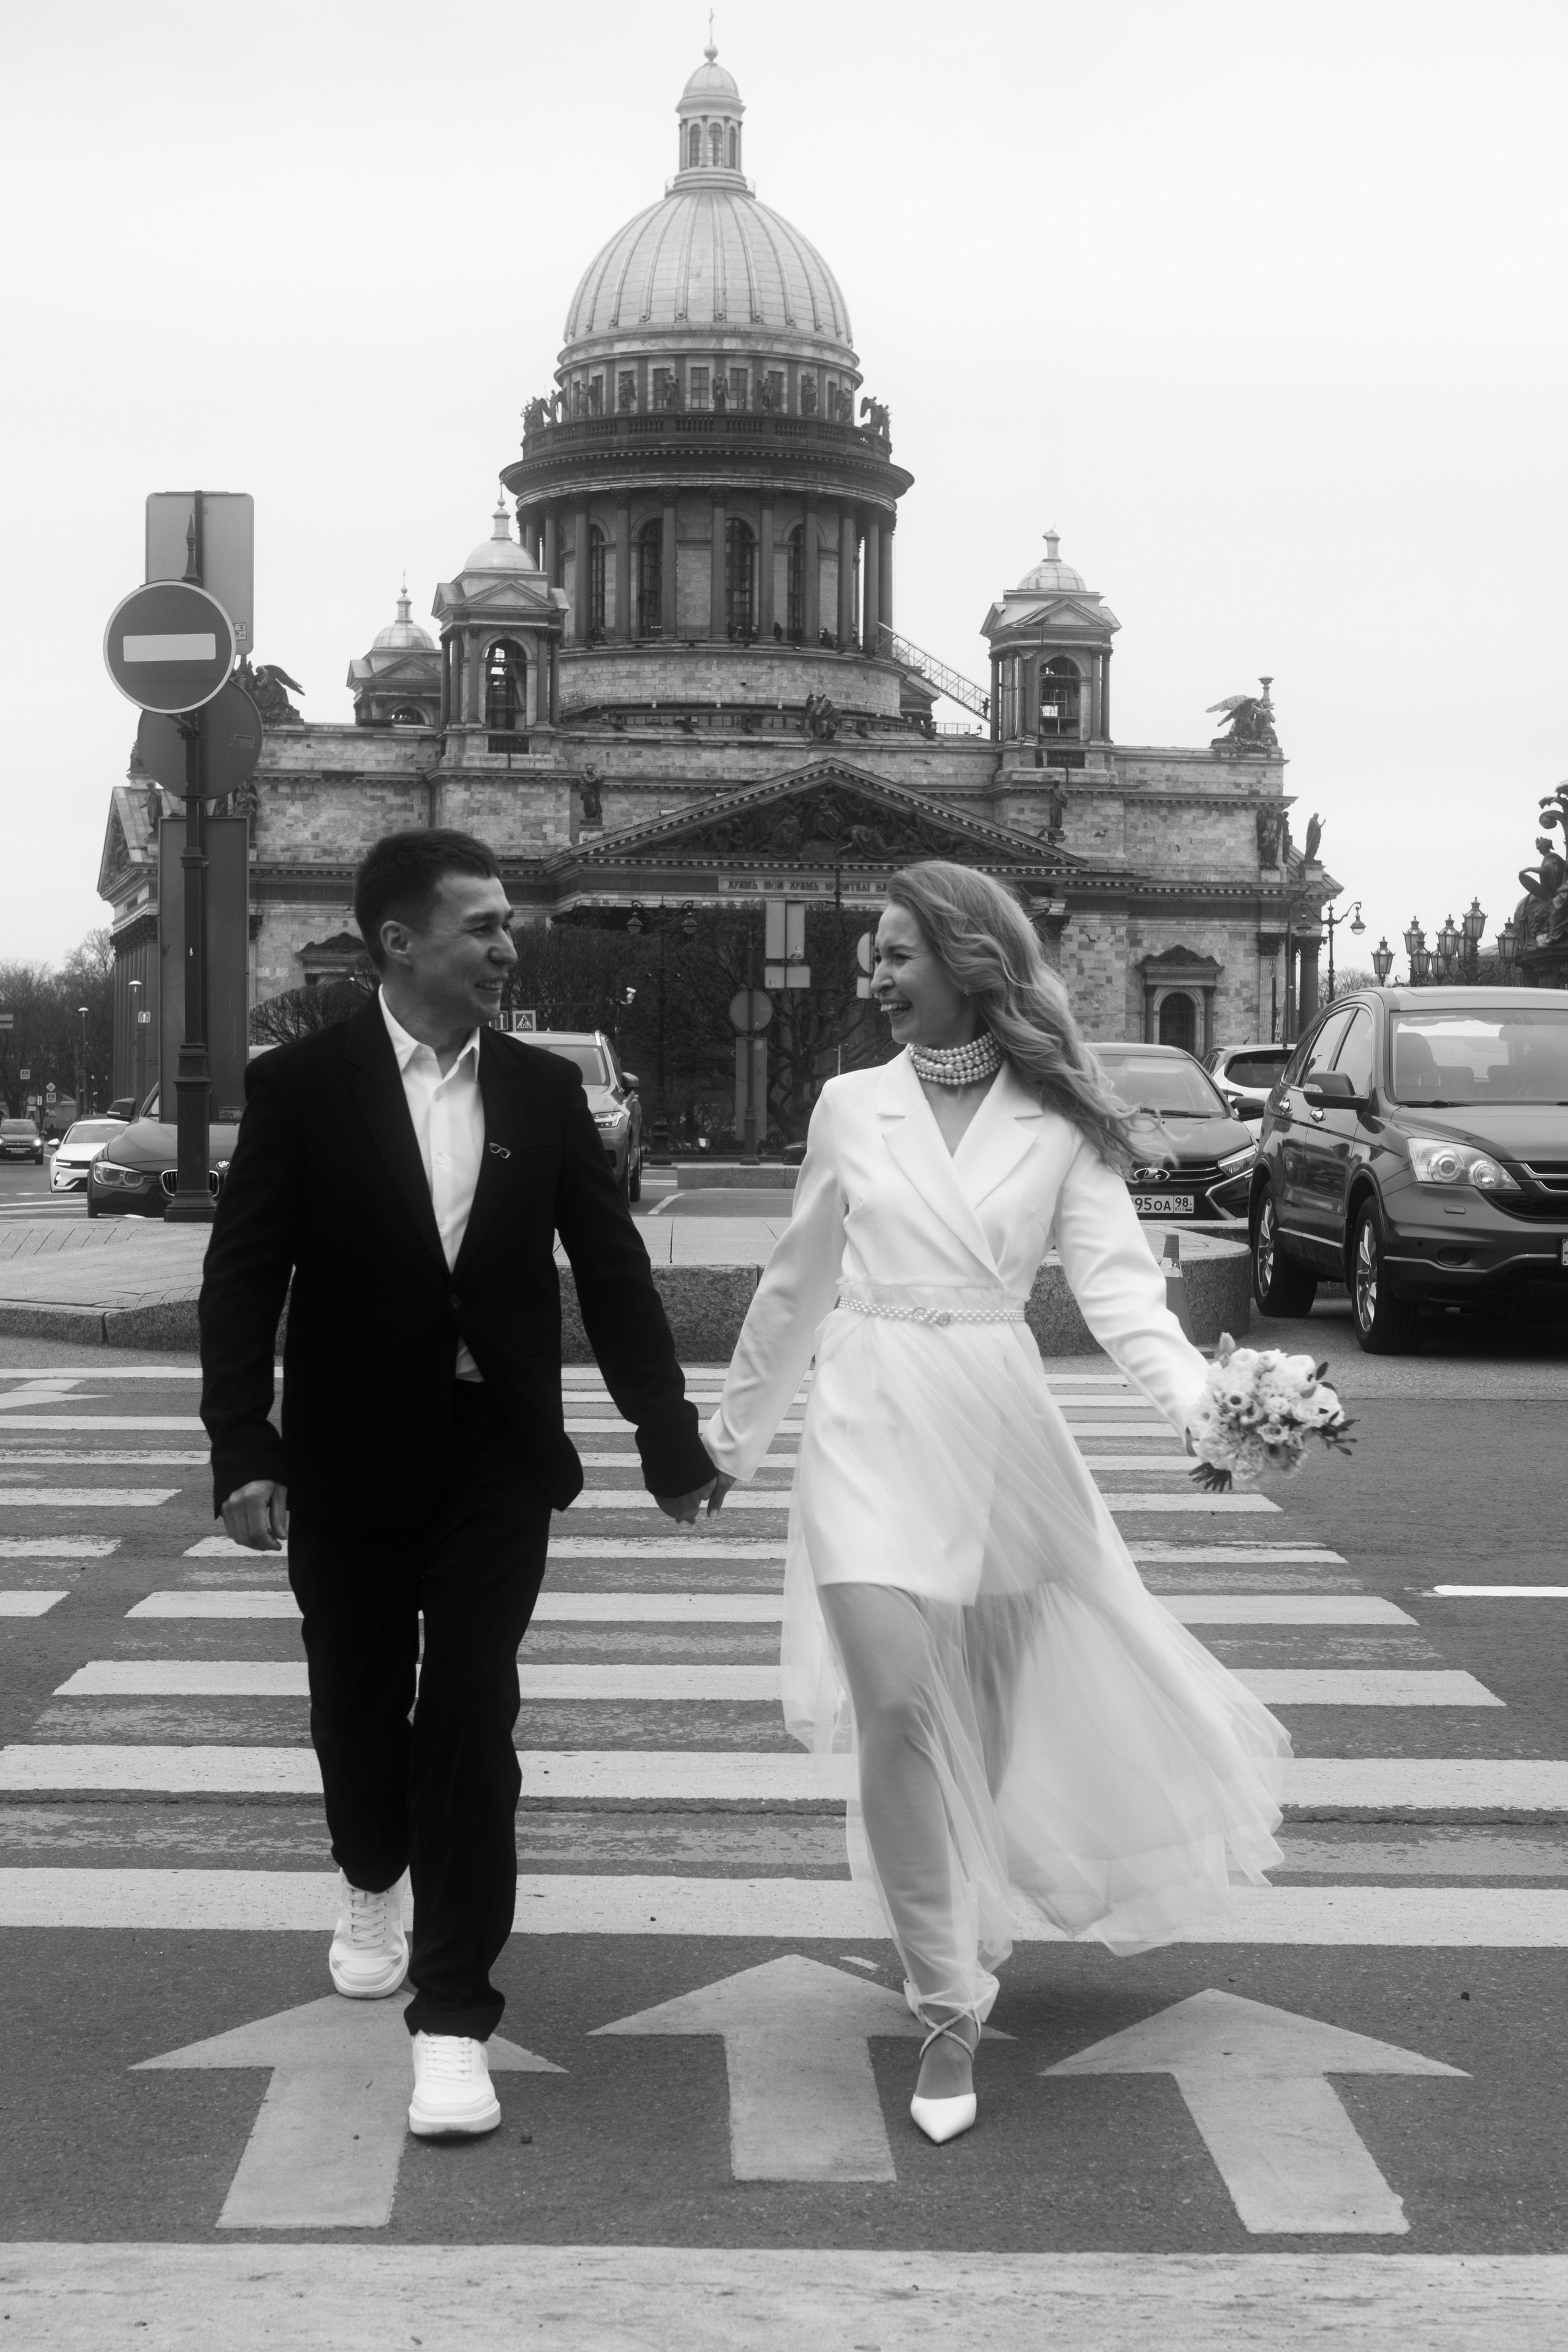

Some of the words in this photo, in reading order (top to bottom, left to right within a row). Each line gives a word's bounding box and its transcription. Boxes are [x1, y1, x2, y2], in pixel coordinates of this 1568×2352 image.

[728, 880, 758, 890] ХРАМЪ
[790, 881, 819, 891] ХРАМЪ
[1131, 1197, 1170, 1211] 95OA
[1175, 1197, 1188, 1207] 98
